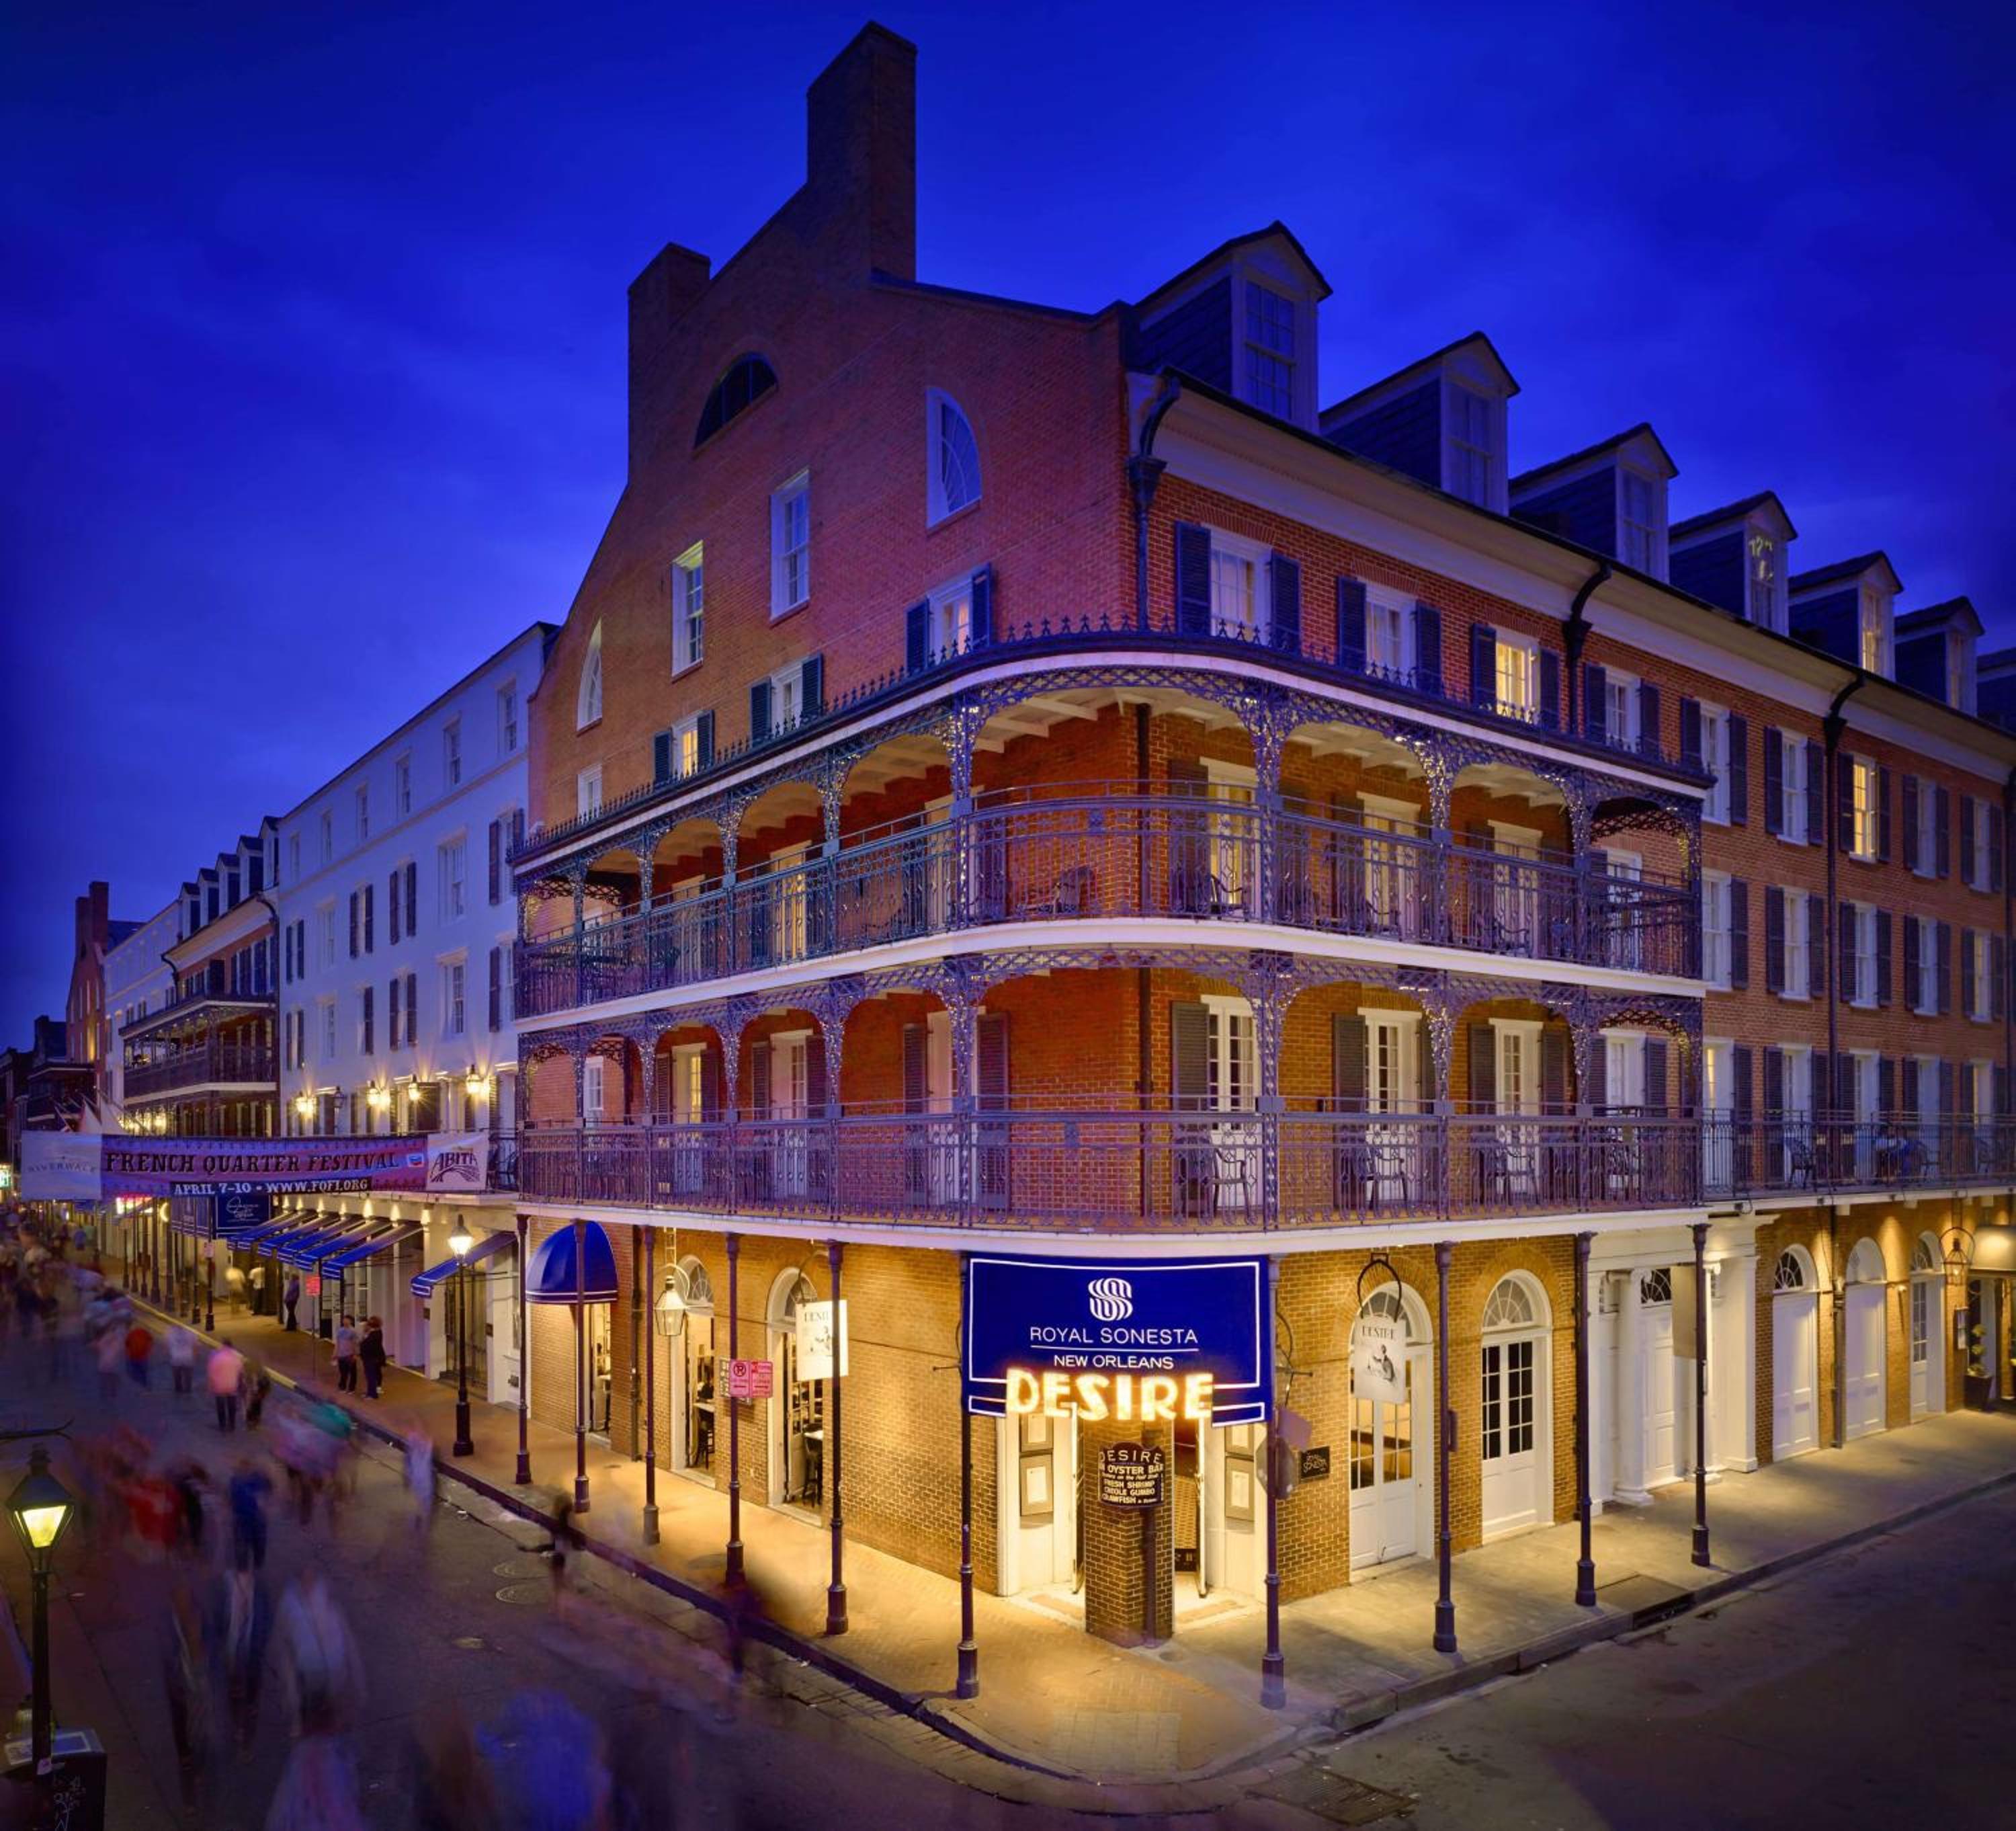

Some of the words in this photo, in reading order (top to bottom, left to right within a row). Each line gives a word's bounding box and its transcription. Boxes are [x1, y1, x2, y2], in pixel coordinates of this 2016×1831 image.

[106, 1152, 195, 1173] FRENCH
[203, 1153, 300, 1175] QUARTER
[308, 1151, 399, 1172] FESTIVAL
[431, 1152, 478, 1174] ABITA
[174, 1184, 216, 1195] APRIL
[218, 1182, 251, 1193] 7-10
[1030, 1326, 1093, 1343] ROYAL
[1100, 1328, 1198, 1344] SONESTA
[1054, 1354, 1088, 1367] NEW
[1092, 1355, 1174, 1369] ORLEANS
[1006, 1367, 1213, 1421] DESIRE
[1098, 1450, 1162, 1464] DESIRE
[1107, 1465, 1144, 1474] OYSTER
[1104, 1479, 1124, 1488] FRESH
[1127, 1479, 1155, 1489] SHRIMP
[1104, 1486, 1127, 1496] CREOLE
[1130, 1488, 1155, 1496] GUMBO
